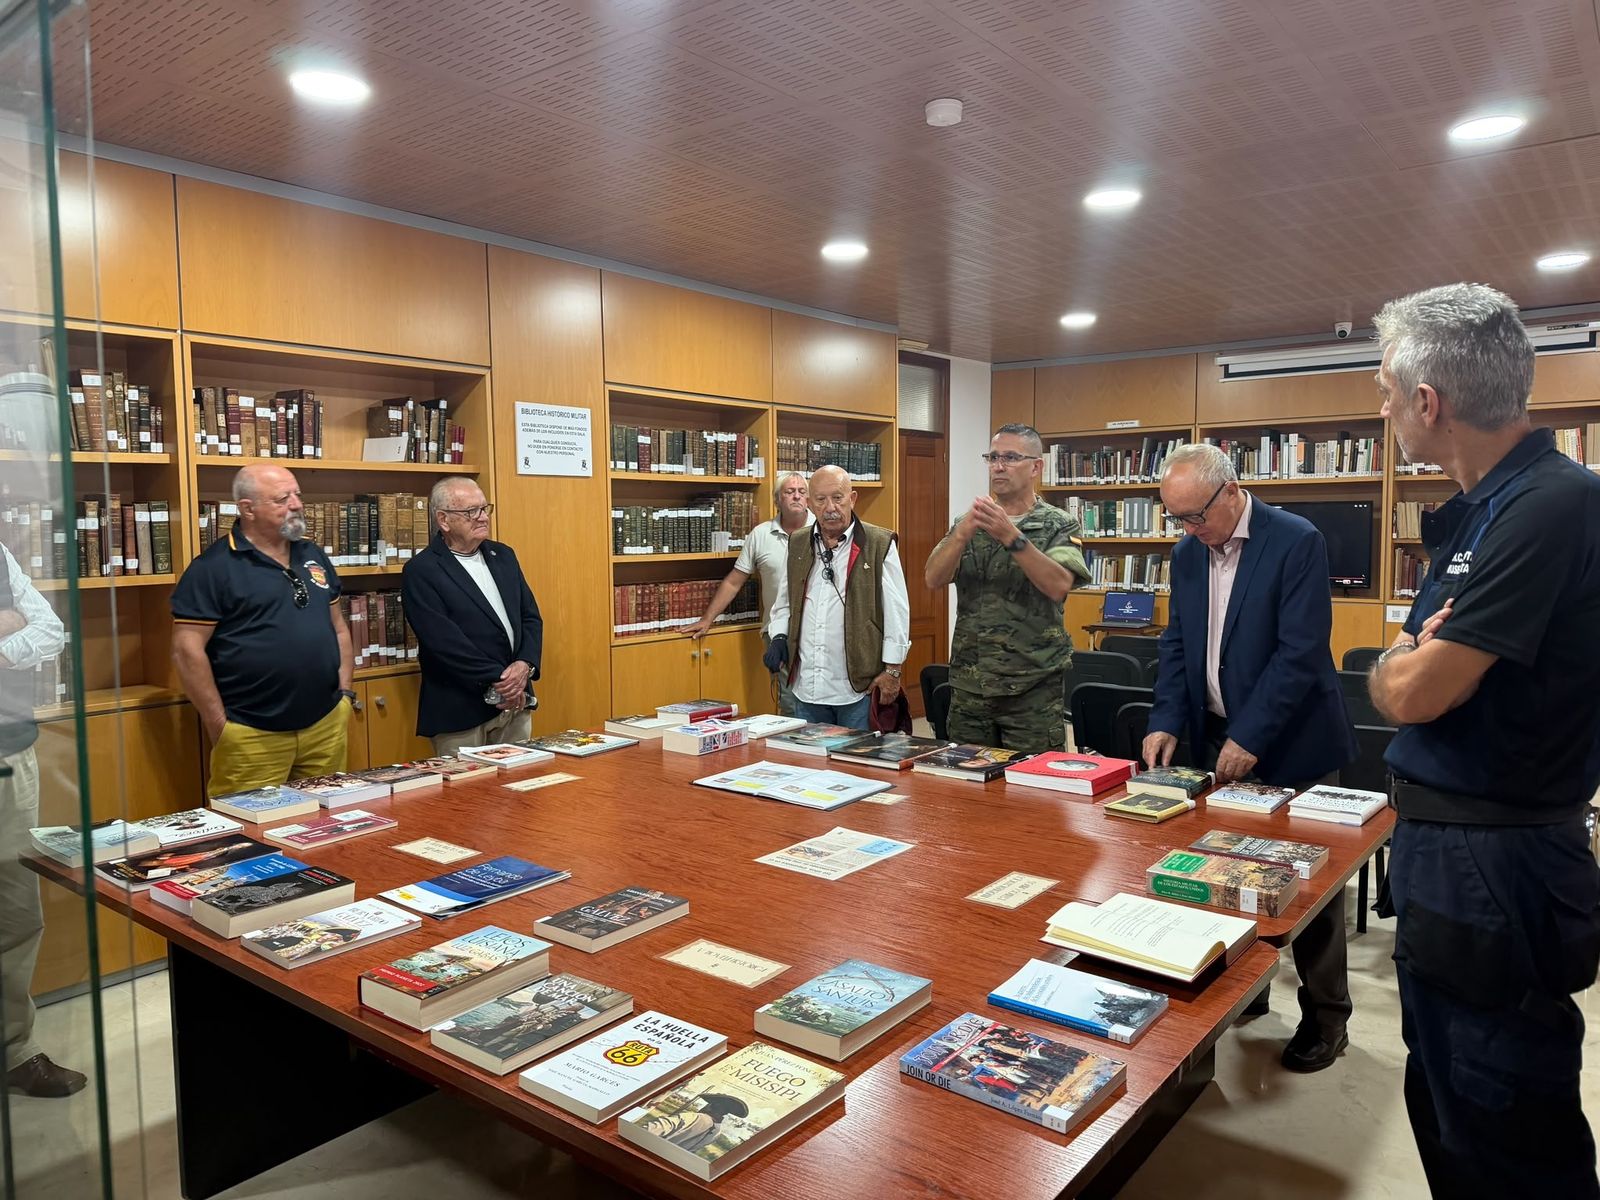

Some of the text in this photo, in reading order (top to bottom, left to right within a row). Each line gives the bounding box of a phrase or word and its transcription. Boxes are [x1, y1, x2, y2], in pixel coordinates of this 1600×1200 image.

[521, 408, 546, 416] BIBLIOTECA
[547, 410, 570, 418] HISTÓRICO
[478, 864, 523, 880] Fernando
[459, 935, 521, 958] LUISIANA
[483, 930, 532, 949] LEJOS
[552, 977, 578, 989] UNA
[823, 979, 886, 1001] ASALTO
[811, 985, 878, 1009] SAN LUIS
[633, 1023, 696, 1050] ESPAÑOLA
[643, 1016, 711, 1044] LA HUELLA
[610, 1048, 639, 1064] 66
[629, 1042, 655, 1055] RUTA
[914, 1042, 949, 1066] JOIN
[942, 1030, 960, 1043] OR
[564, 1062, 590, 1075] MARIO
[742, 1058, 806, 1088] FUEGO
[906, 1064, 951, 1089] JOIN OR DIE
[728, 1067, 803, 1102] MISISIPI
